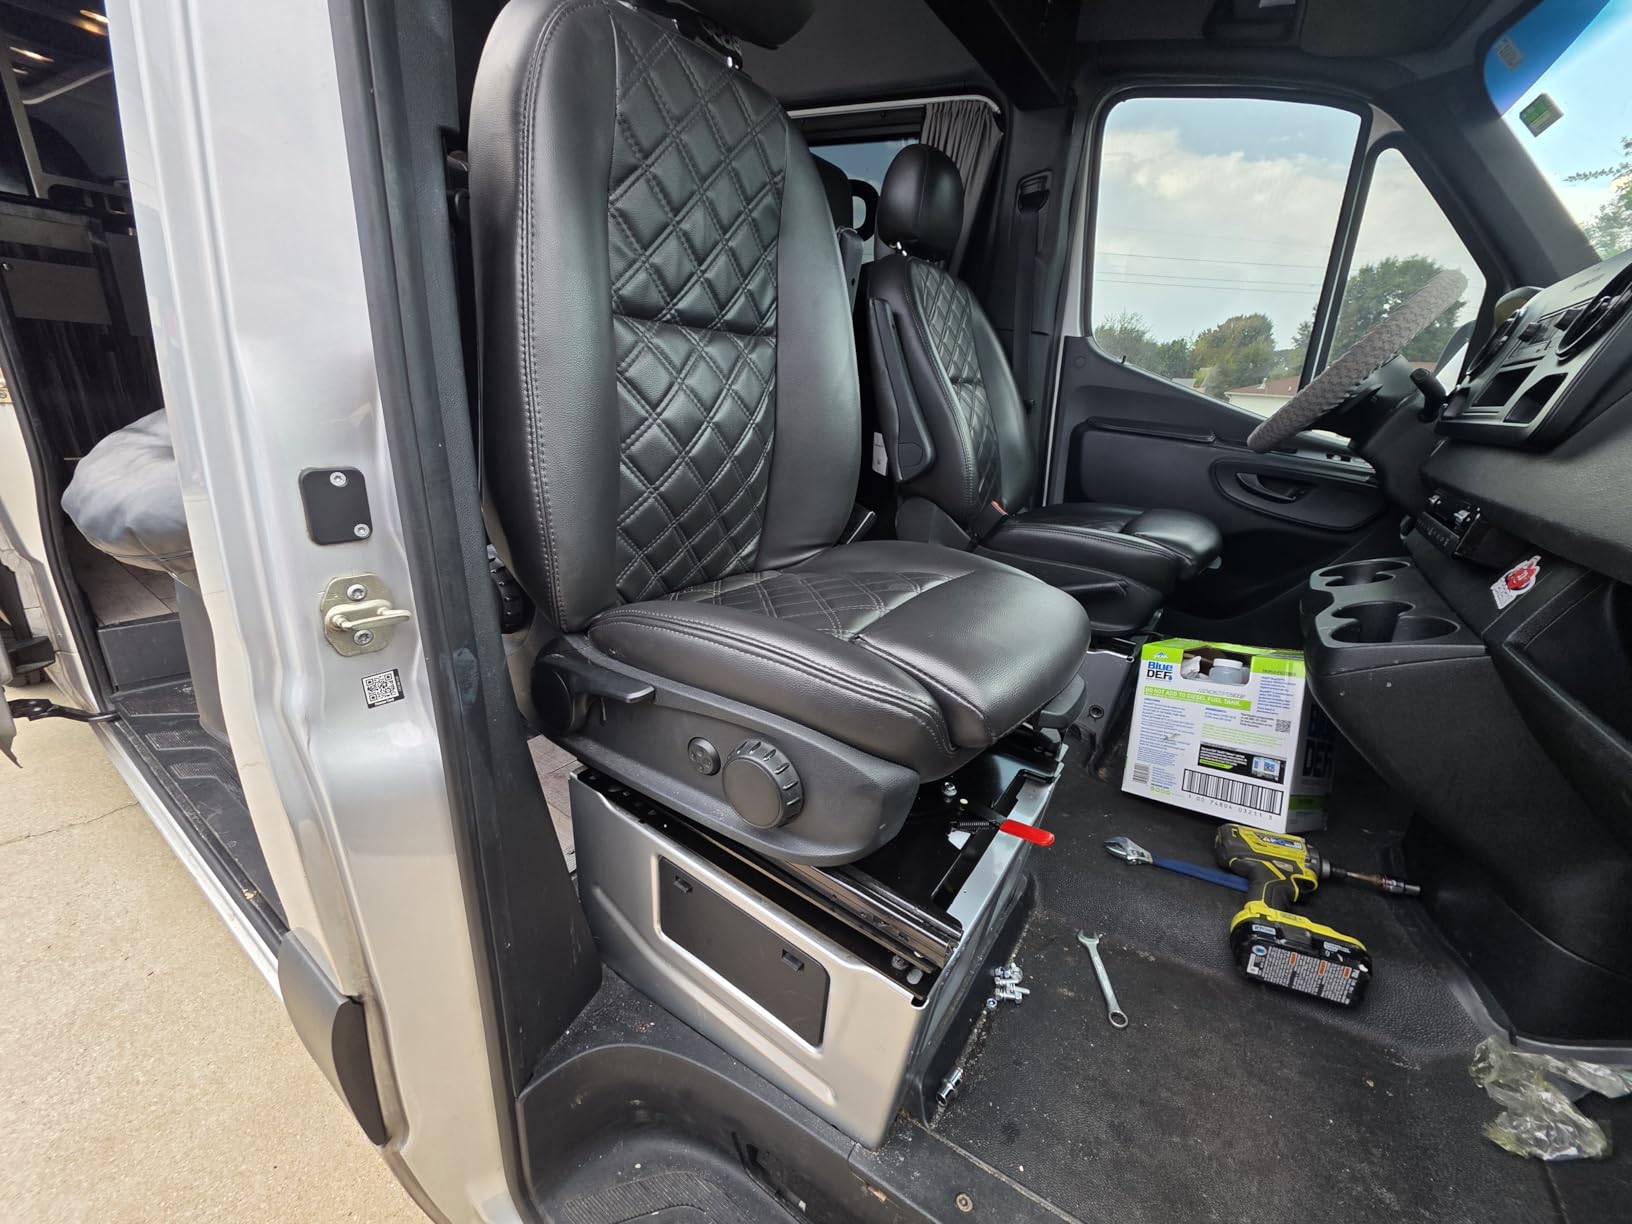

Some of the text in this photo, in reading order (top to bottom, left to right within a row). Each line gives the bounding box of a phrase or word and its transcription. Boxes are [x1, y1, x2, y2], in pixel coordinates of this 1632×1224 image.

[1147, 661, 1173, 672] Blue
[1146, 669, 1173, 681] DEF
[1154, 687, 1165, 695] NOT
[1166, 689, 1177, 697] ADD
[1178, 690, 1186, 698] TO
[1187, 691, 1206, 701] DIESEL
[1207, 696, 1222, 704] FUEL
